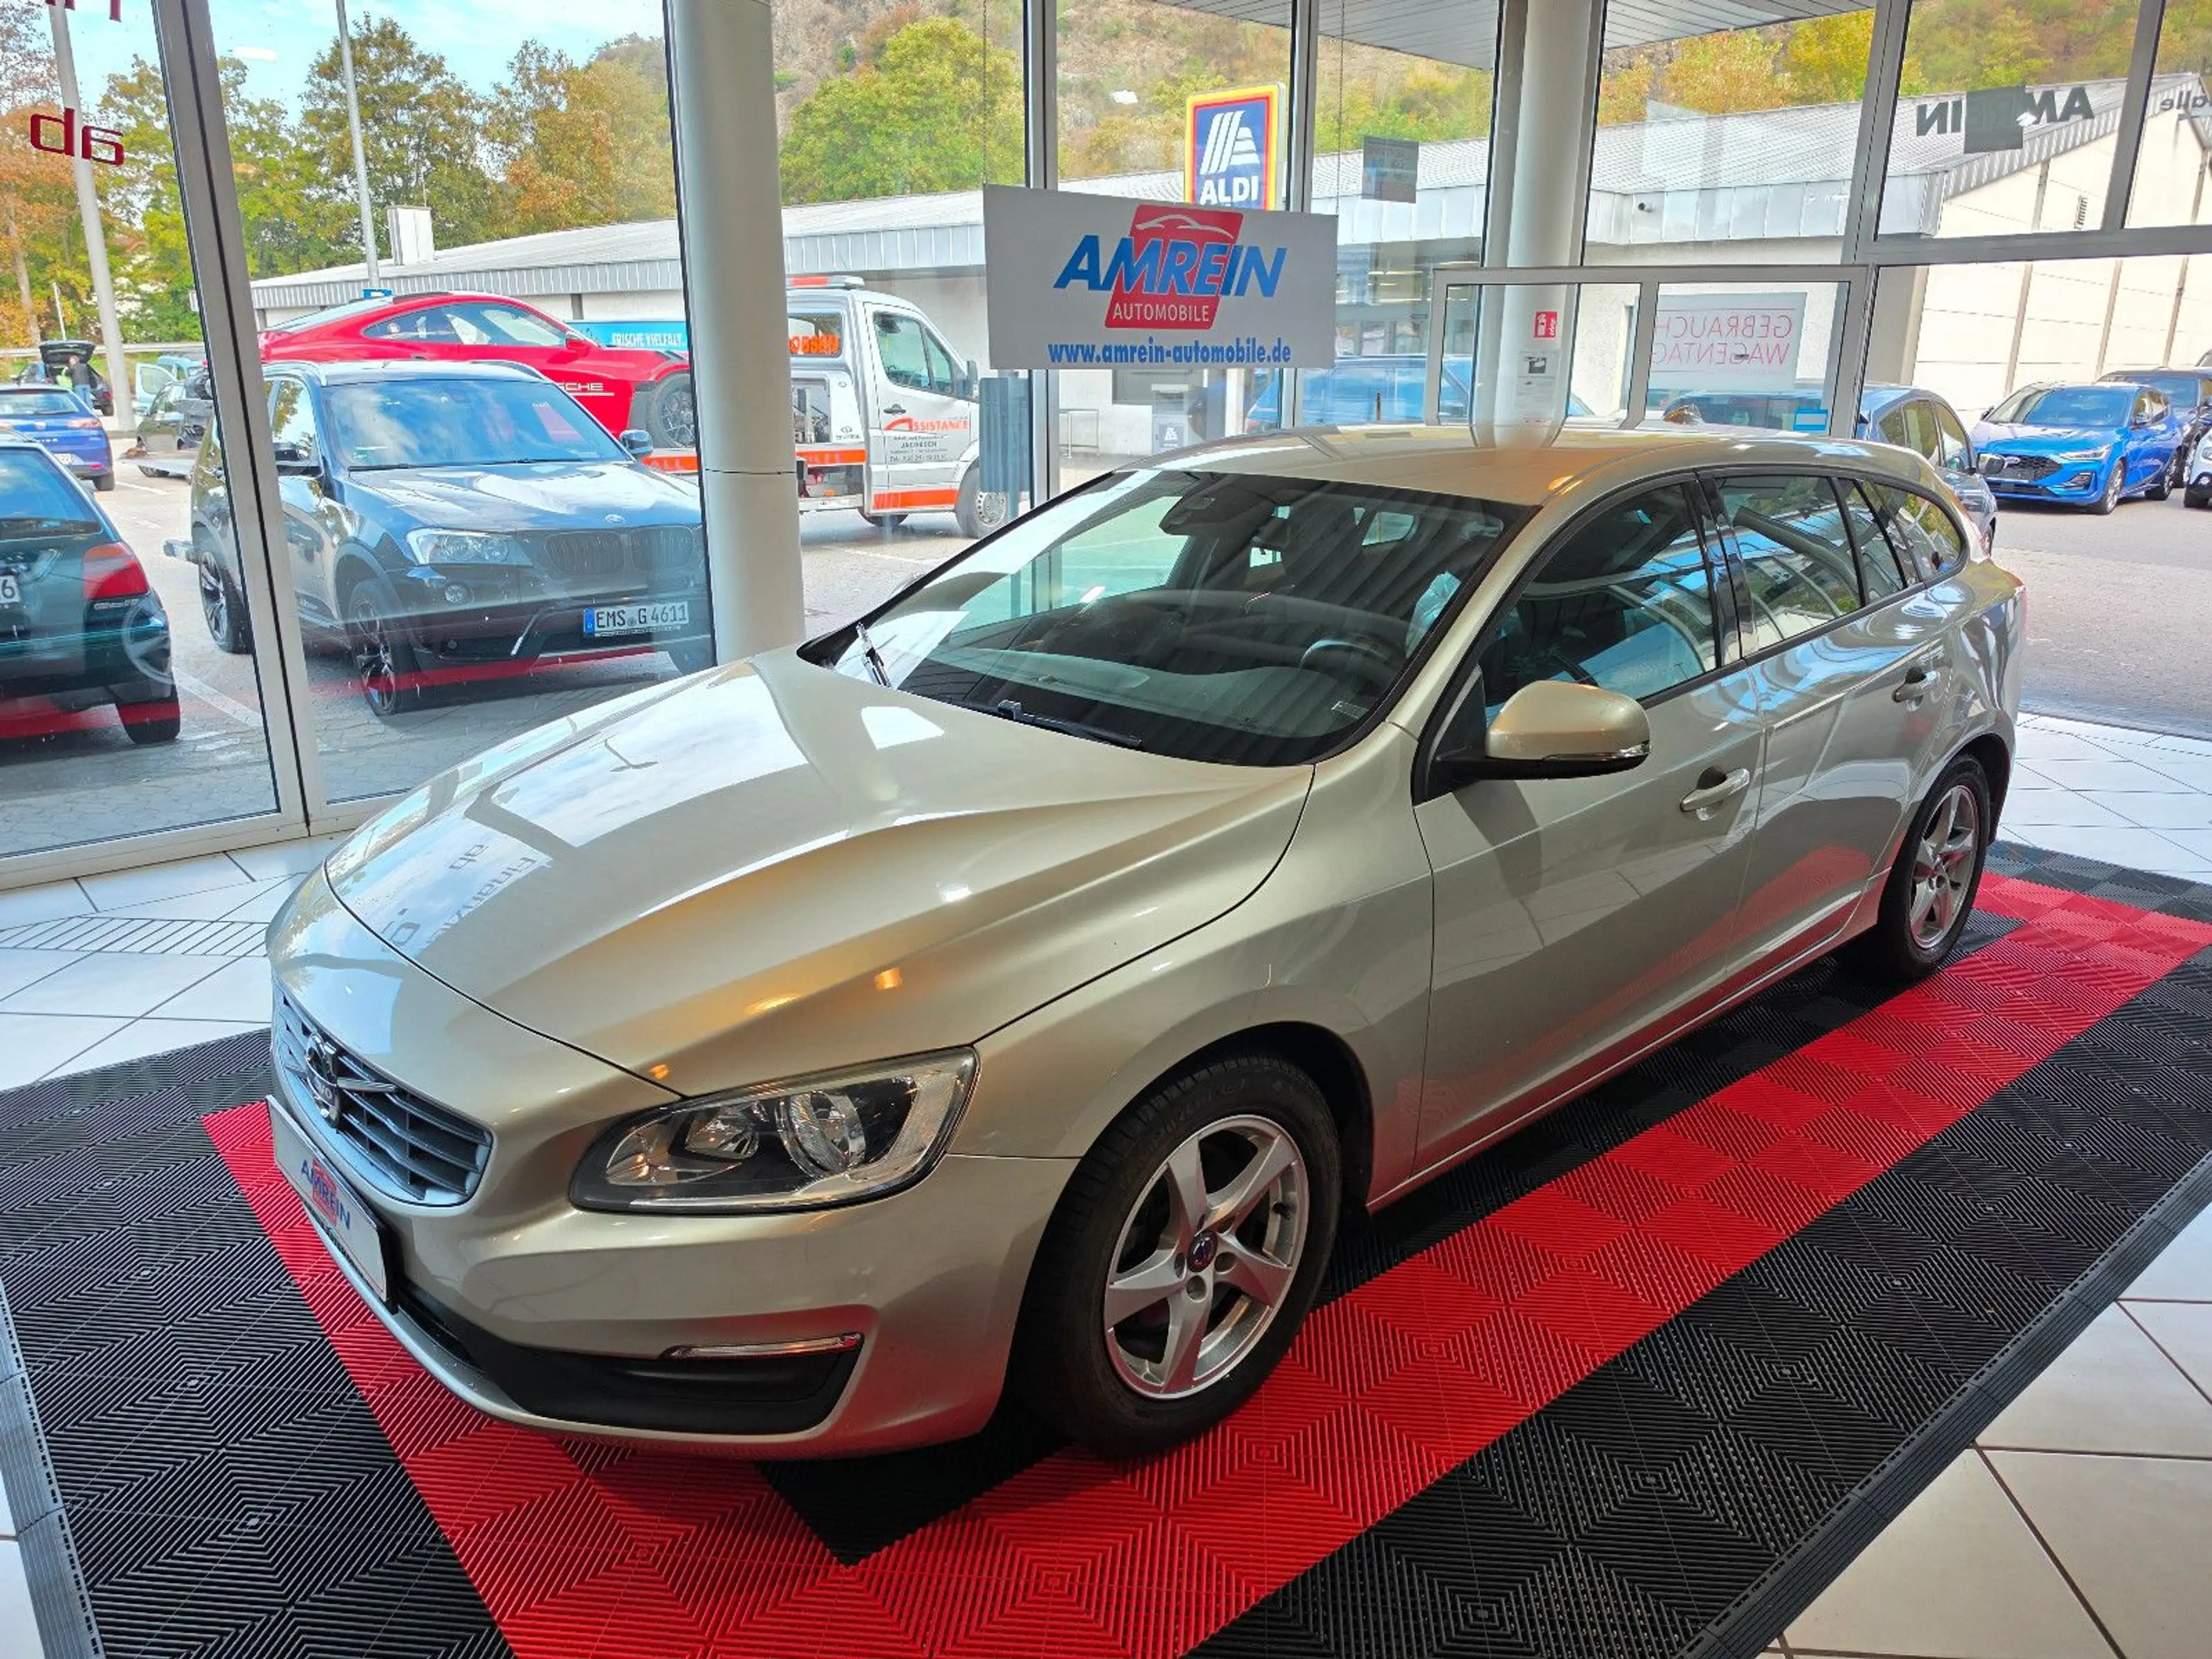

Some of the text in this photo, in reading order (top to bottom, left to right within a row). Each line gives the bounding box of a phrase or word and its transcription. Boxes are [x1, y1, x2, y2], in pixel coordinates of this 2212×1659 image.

[1199, 175, 1259, 206] ALDI
[1053, 234, 1288, 298] AMREIN
[1112, 302, 1210, 322] AUTOMOBILE
[1047, 336, 1291, 364] www.amrein-automobile.de
[596, 609, 626, 628] EMS
[301, 1159, 351, 1230] AMREIN
